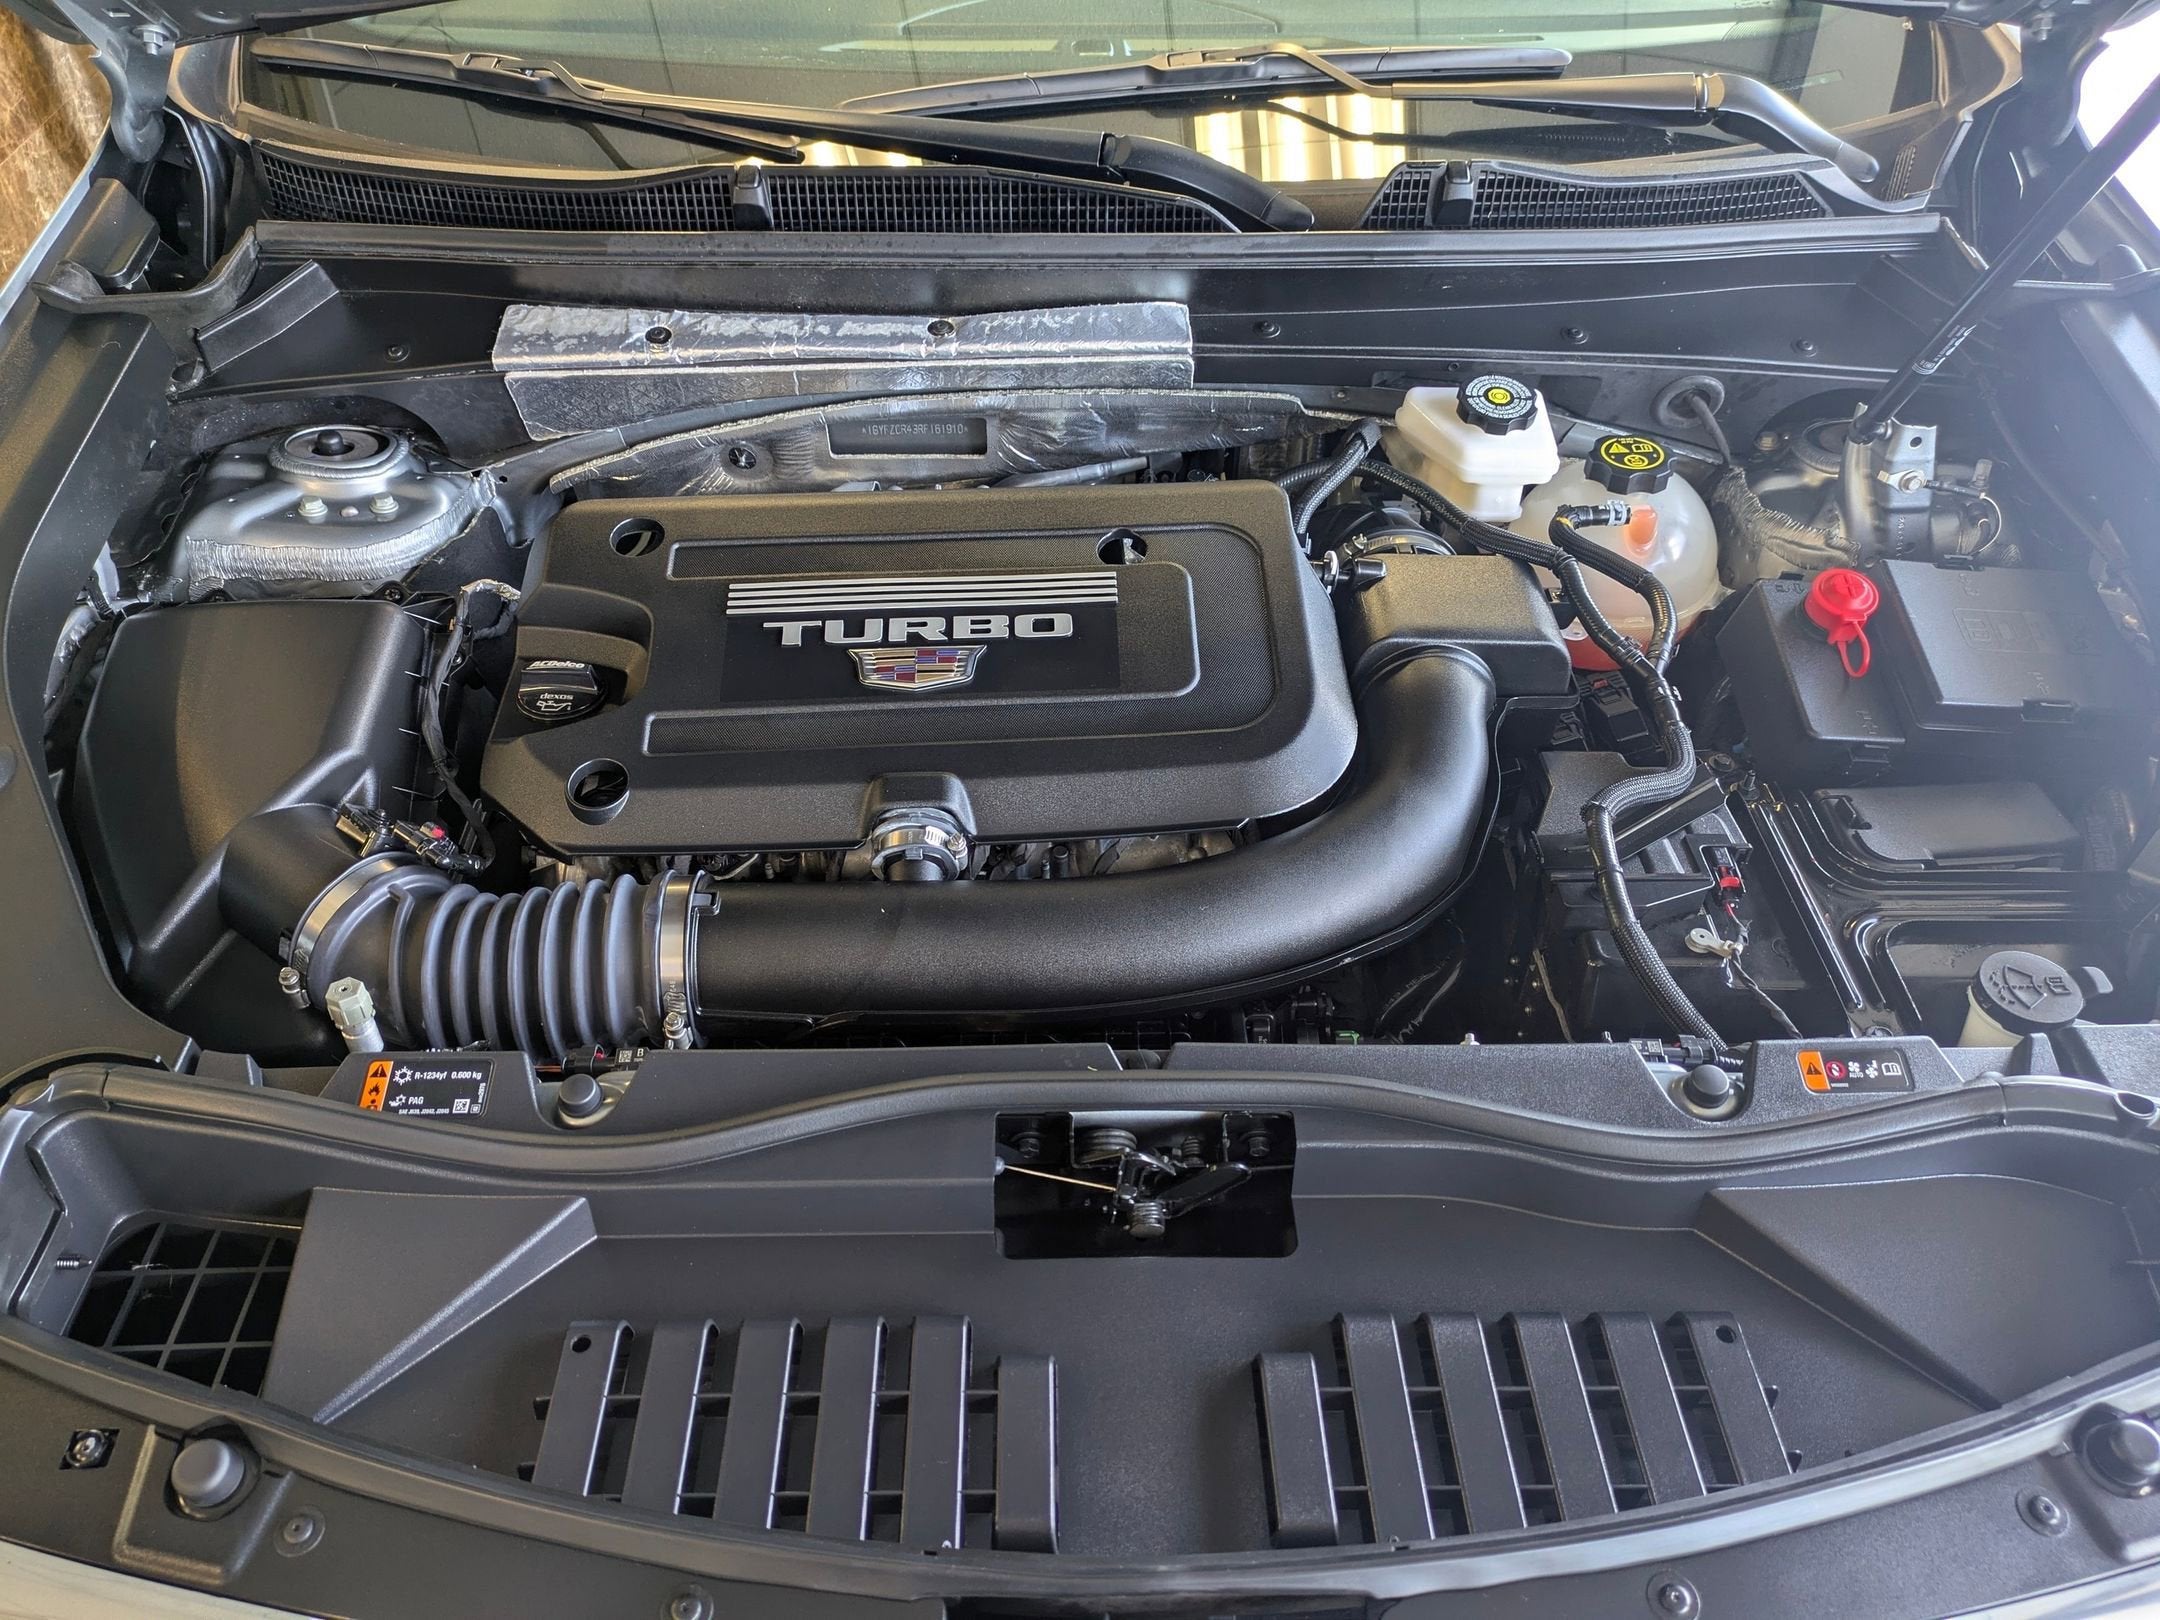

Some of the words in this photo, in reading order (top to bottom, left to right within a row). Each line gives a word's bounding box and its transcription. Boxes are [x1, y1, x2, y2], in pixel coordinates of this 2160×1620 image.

[762, 613, 1074, 647] TURBO
[540, 692, 574, 700] dexos
[637, 1048, 644, 1057] B
[451, 1071, 471, 1080] 0.600
[472, 1071, 482, 1080] kg
[408, 1096, 424, 1105] PAG
